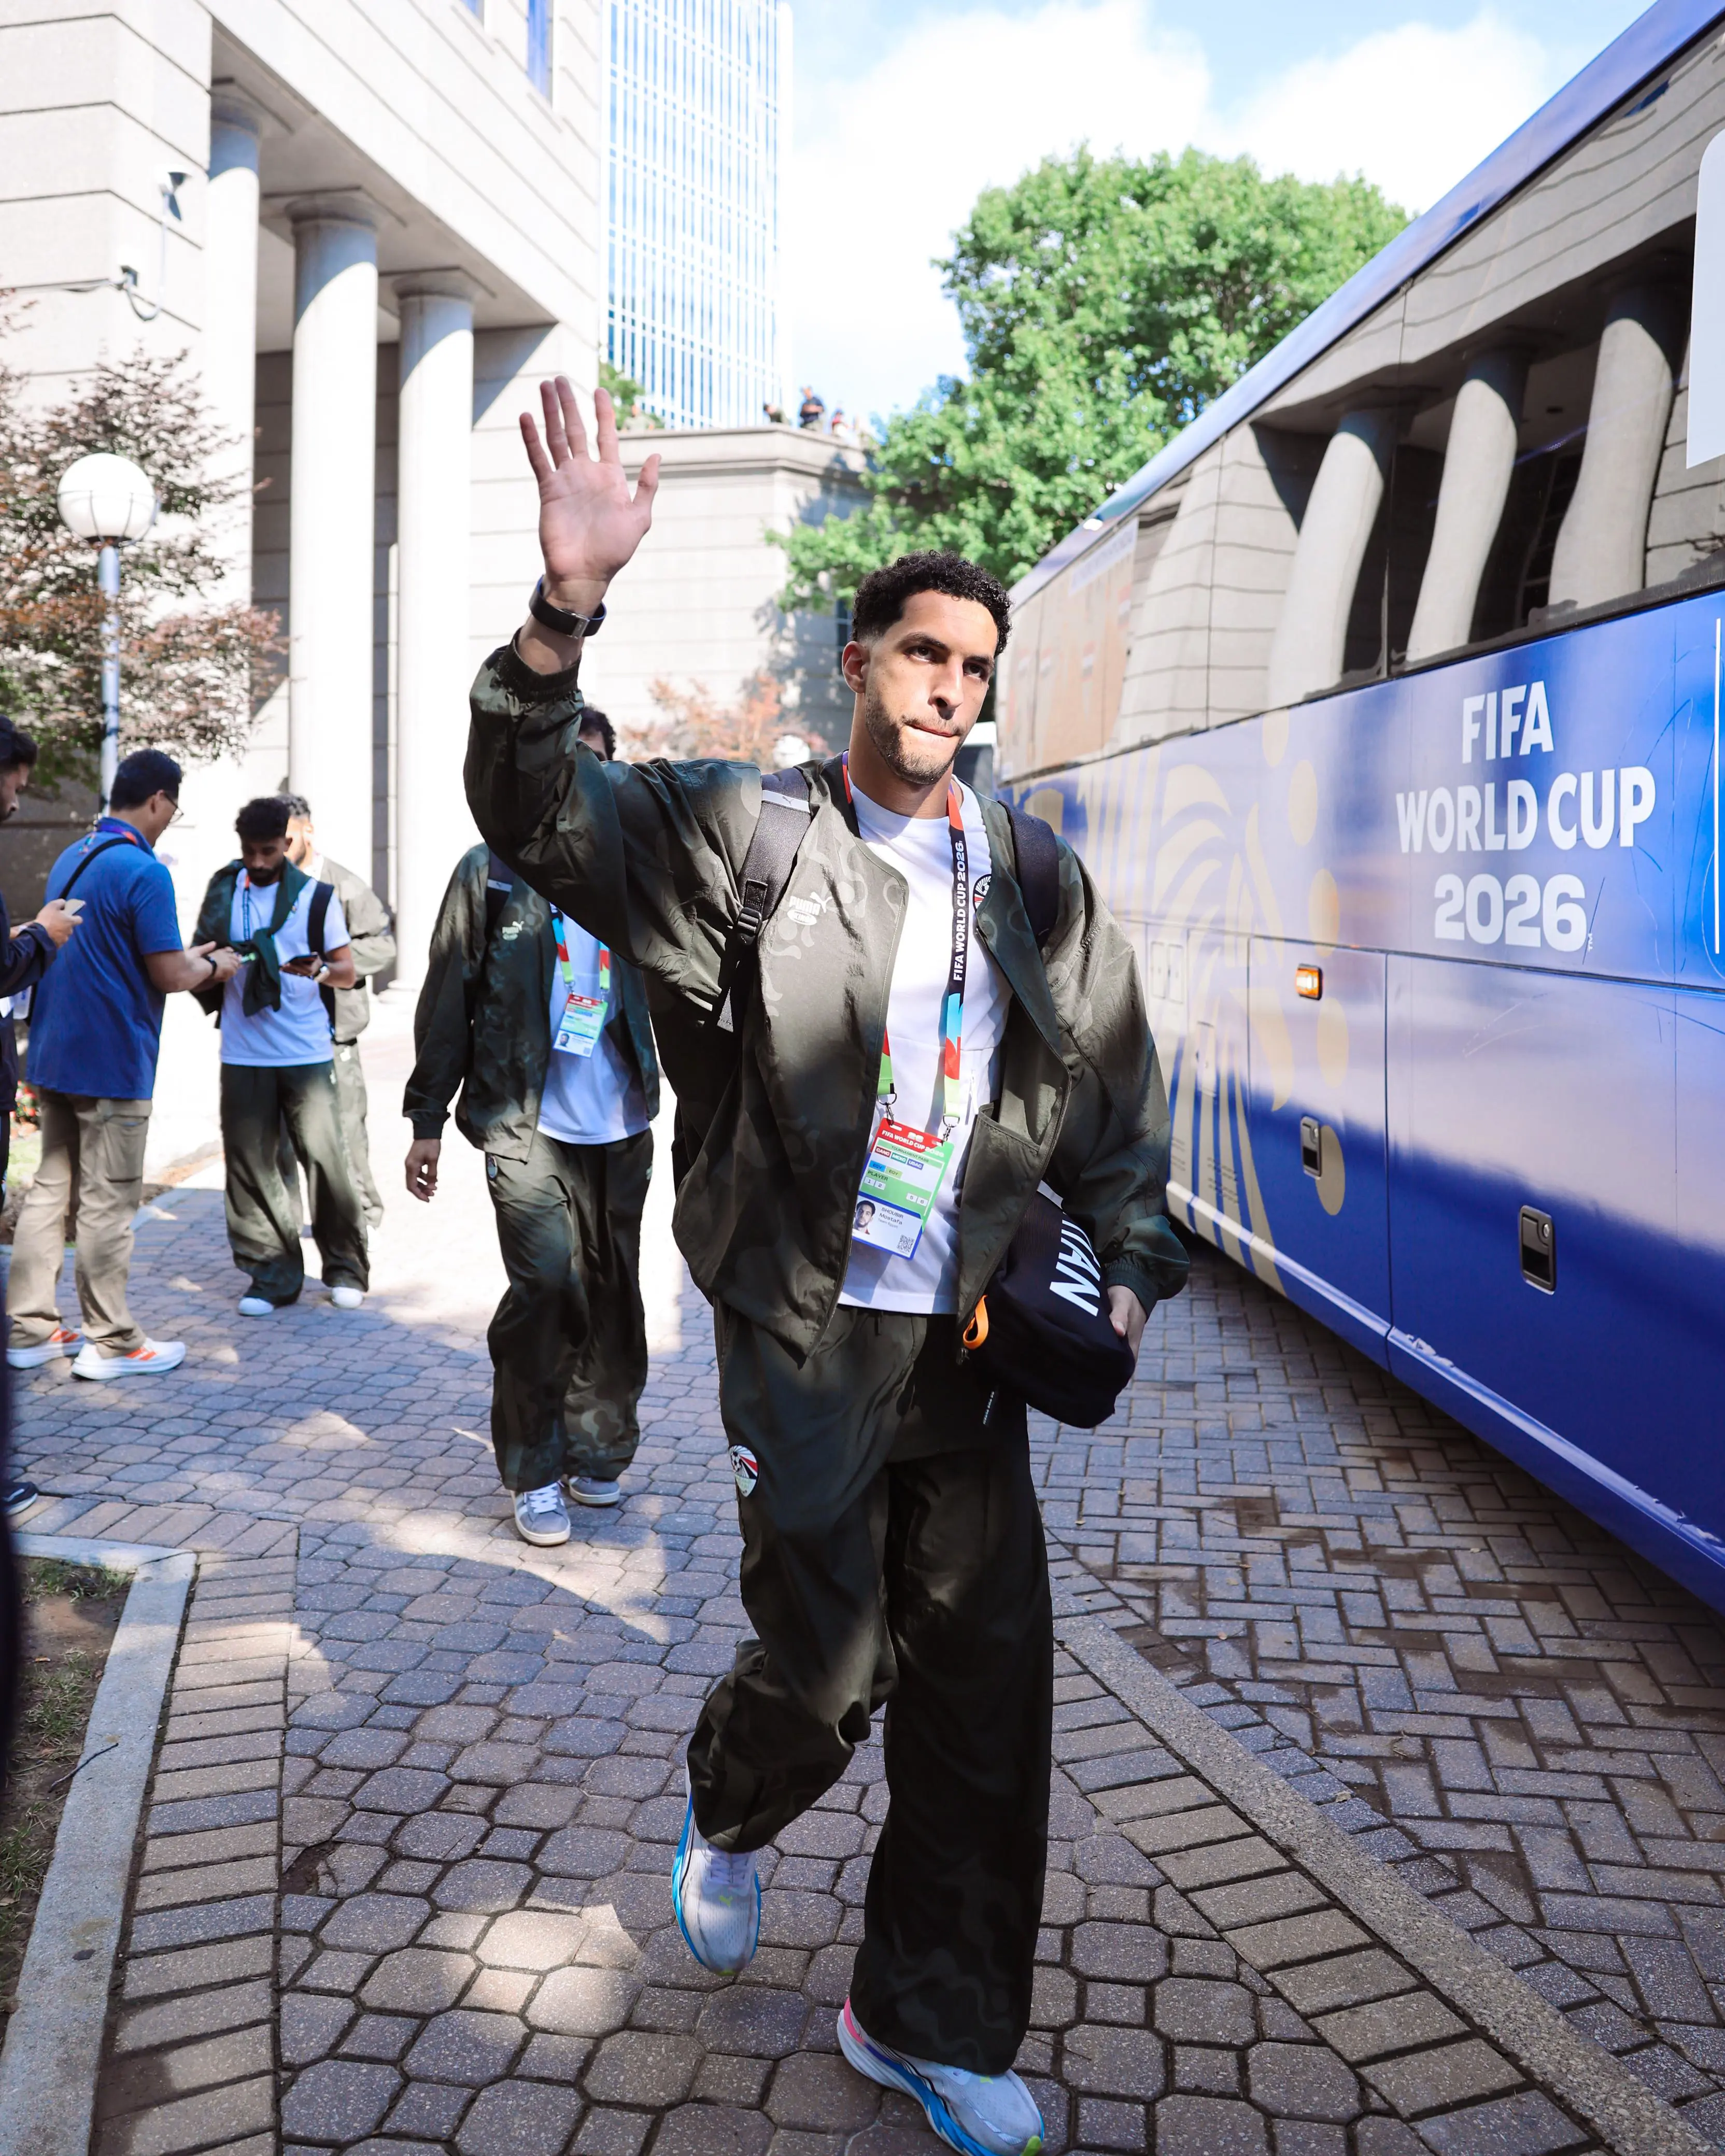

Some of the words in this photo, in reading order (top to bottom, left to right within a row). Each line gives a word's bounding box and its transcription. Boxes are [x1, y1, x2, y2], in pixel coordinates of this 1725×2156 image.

[1462, 680, 1554, 764] FIFA
[1396, 779, 1538, 854] WORLD
[1547, 766, 1656, 850] CUP
[955, 842, 966, 882] 2026
[957, 883, 966, 907] CUP
[1434, 873, 1587, 952] 2026
[955, 909, 966, 953] WORLD
[953, 954, 964, 981] FIFA
[882, 1130, 894, 1139] FIFA
[894, 1134, 913, 1146] WORLD
[892, 1145, 918, 1159] TOURNAMENT
[868, 1170, 888, 1181] PLAYER
[879, 1213, 902, 1225] Mostafa
[881, 1207, 904, 1219] SHOUBIR
